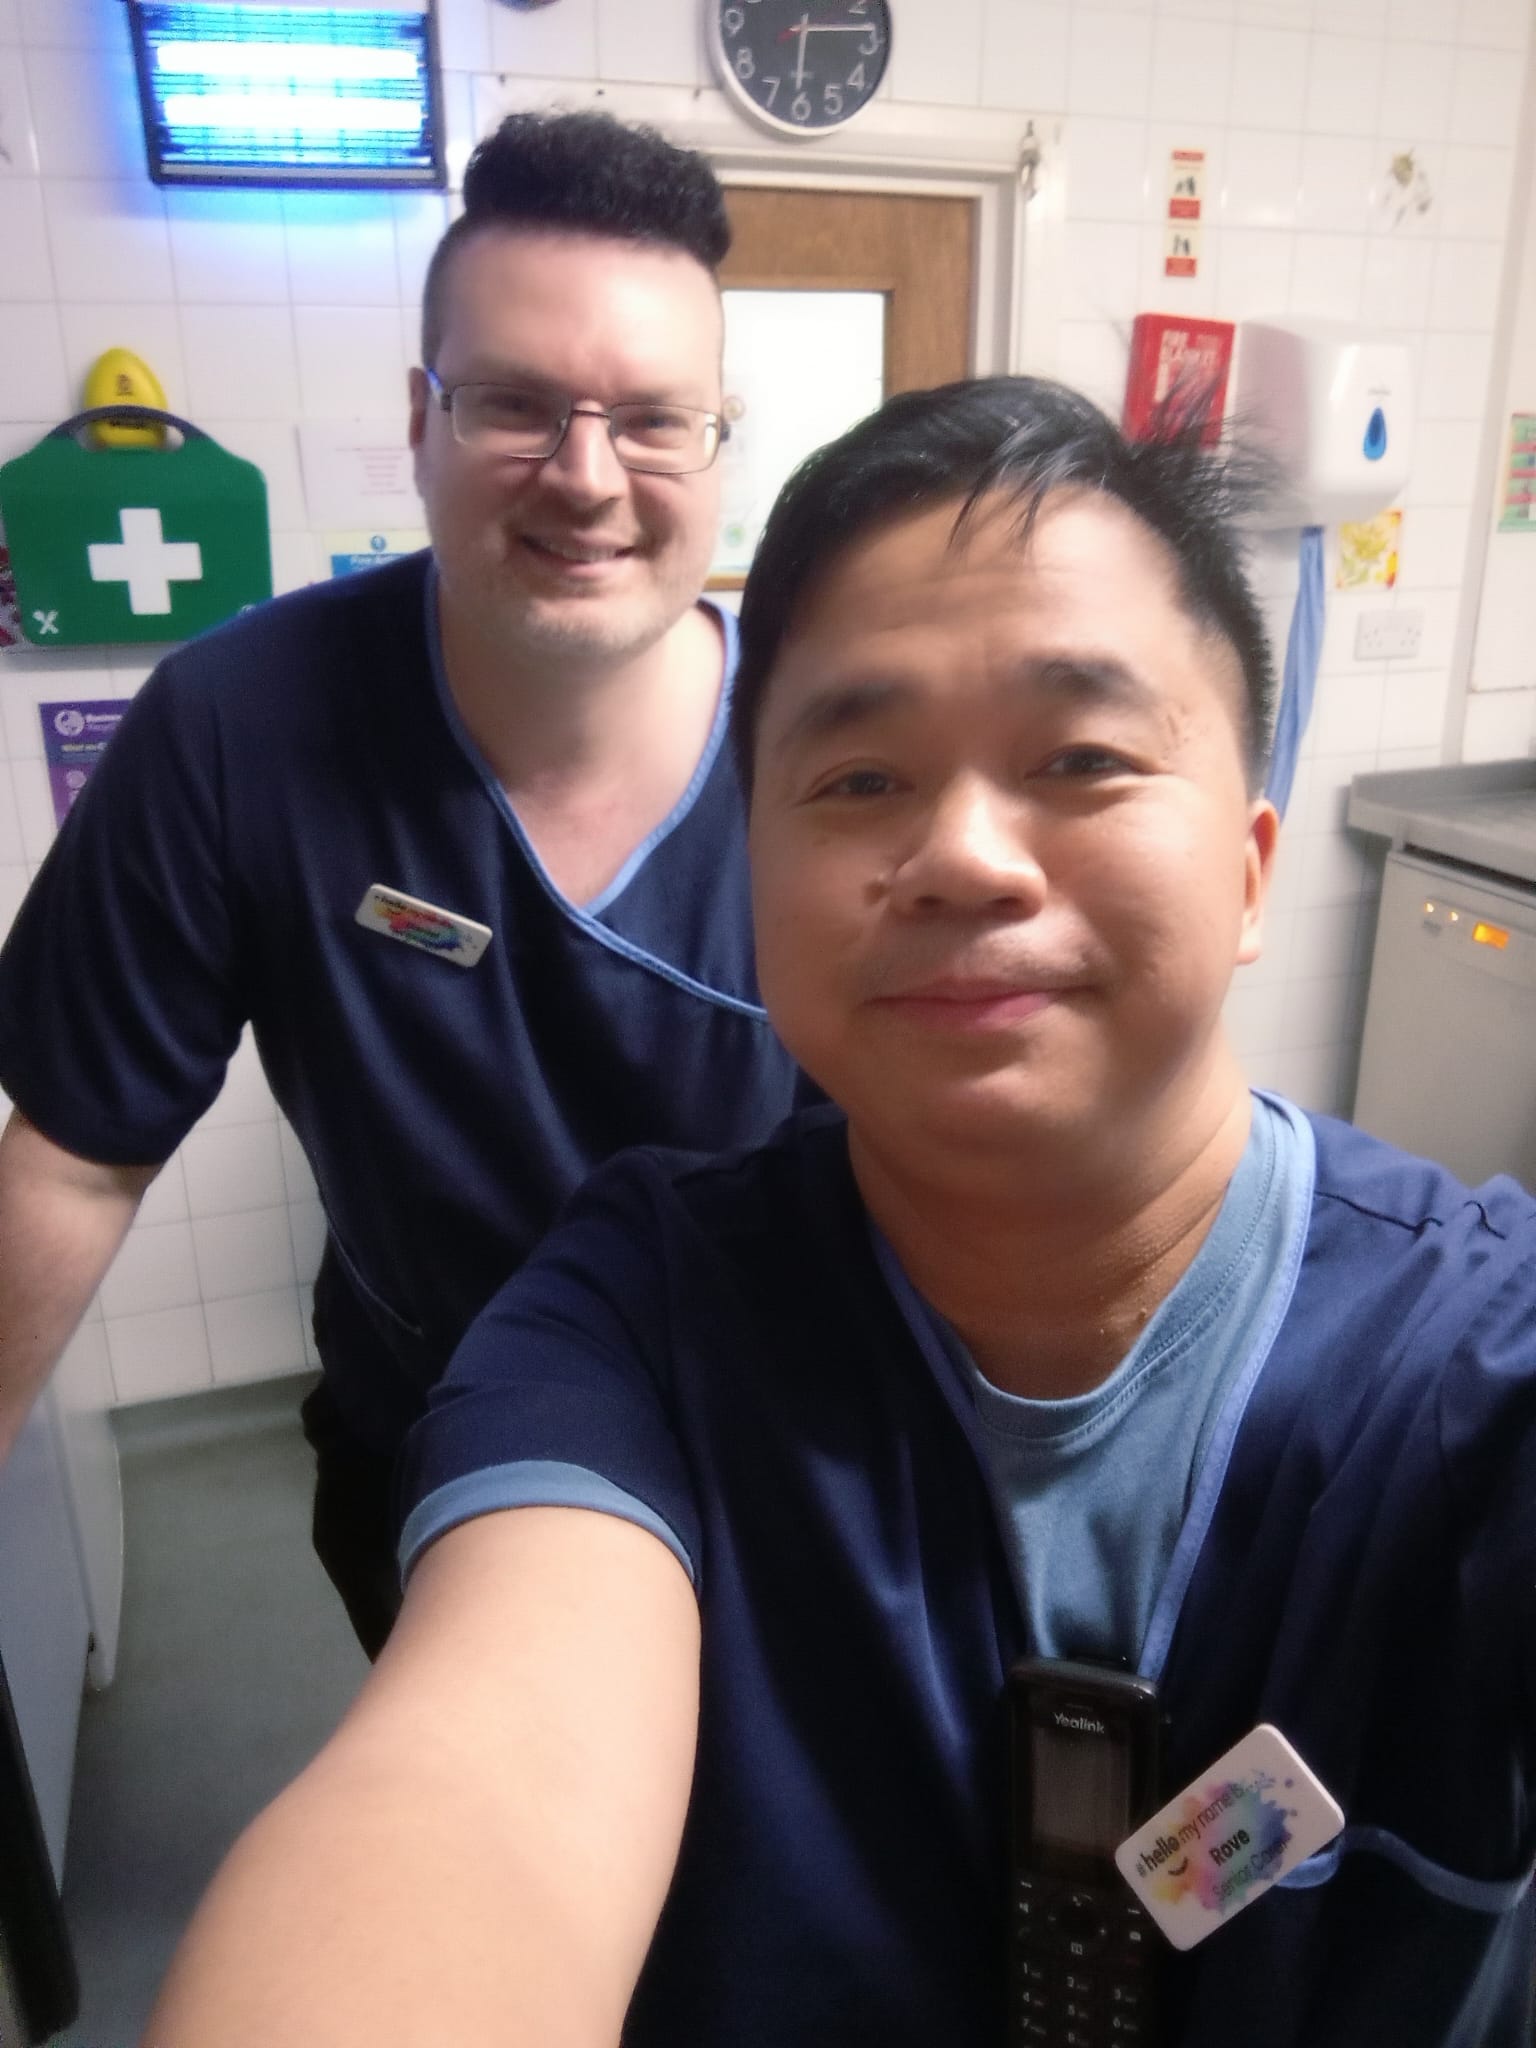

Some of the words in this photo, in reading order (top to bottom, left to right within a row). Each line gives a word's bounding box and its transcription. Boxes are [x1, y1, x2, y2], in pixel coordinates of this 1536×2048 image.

[724, 8, 745, 37] 9
[735, 47, 755, 79] 8
[847, 63, 865, 91] 4
[762, 77, 781, 109] 7
[791, 92, 811, 121] 6
[824, 83, 843, 115] 5
[1053, 1711, 1105, 1734] Yealink
[1136, 1835, 1180, 1878] #hello
[1178, 1818, 1201, 1844] my
[1197, 1794, 1233, 1828] name
[1208, 1829, 1250, 1868] Rove
